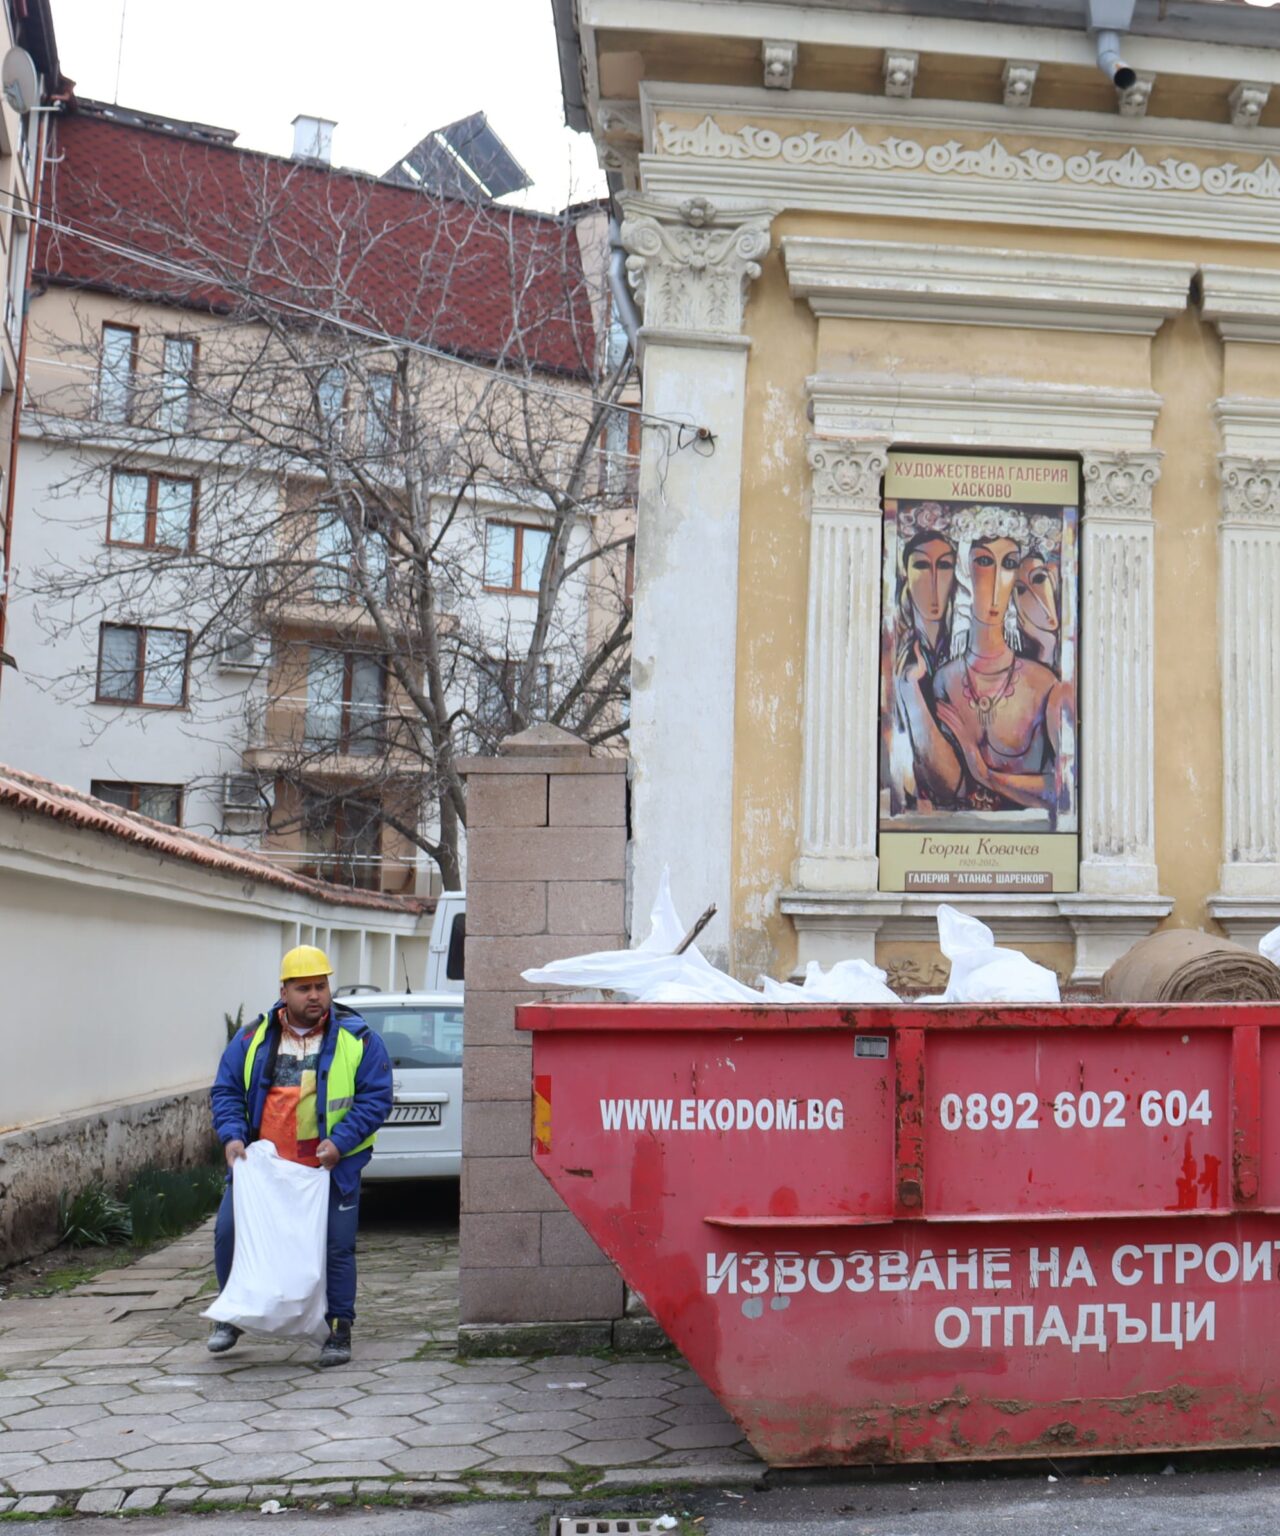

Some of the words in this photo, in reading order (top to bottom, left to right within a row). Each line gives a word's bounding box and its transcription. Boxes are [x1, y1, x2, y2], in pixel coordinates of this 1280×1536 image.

[894, 462, 1005, 481] ХУДОЖЕСТВЕНА
[1008, 466, 1068, 483] ГАЛЕРИЯ
[951, 482, 1012, 498] ХАСКОВО
[920, 837, 970, 858] Георги
[976, 838, 1040, 856] Ковачев
[908, 873, 950, 884] ГАЛЕРИЯ
[953, 873, 993, 884] "АТАНАС
[995, 874, 1049, 884] ШАРЕНКОВ"
[387, 1106, 436, 1120] 7777X
[600, 1098, 844, 1131] WWW.EKODOM.BG
[939, 1091, 1039, 1131] 0892
[1053, 1090, 1126, 1129] 602
[1139, 1089, 1212, 1127] 604
[706, 1248, 1012, 1295] ИЗВОЗВАНЕ
[1029, 1246, 1098, 1289] НА
[934, 1301, 1216, 1353] ОТПАДЪЦИ
